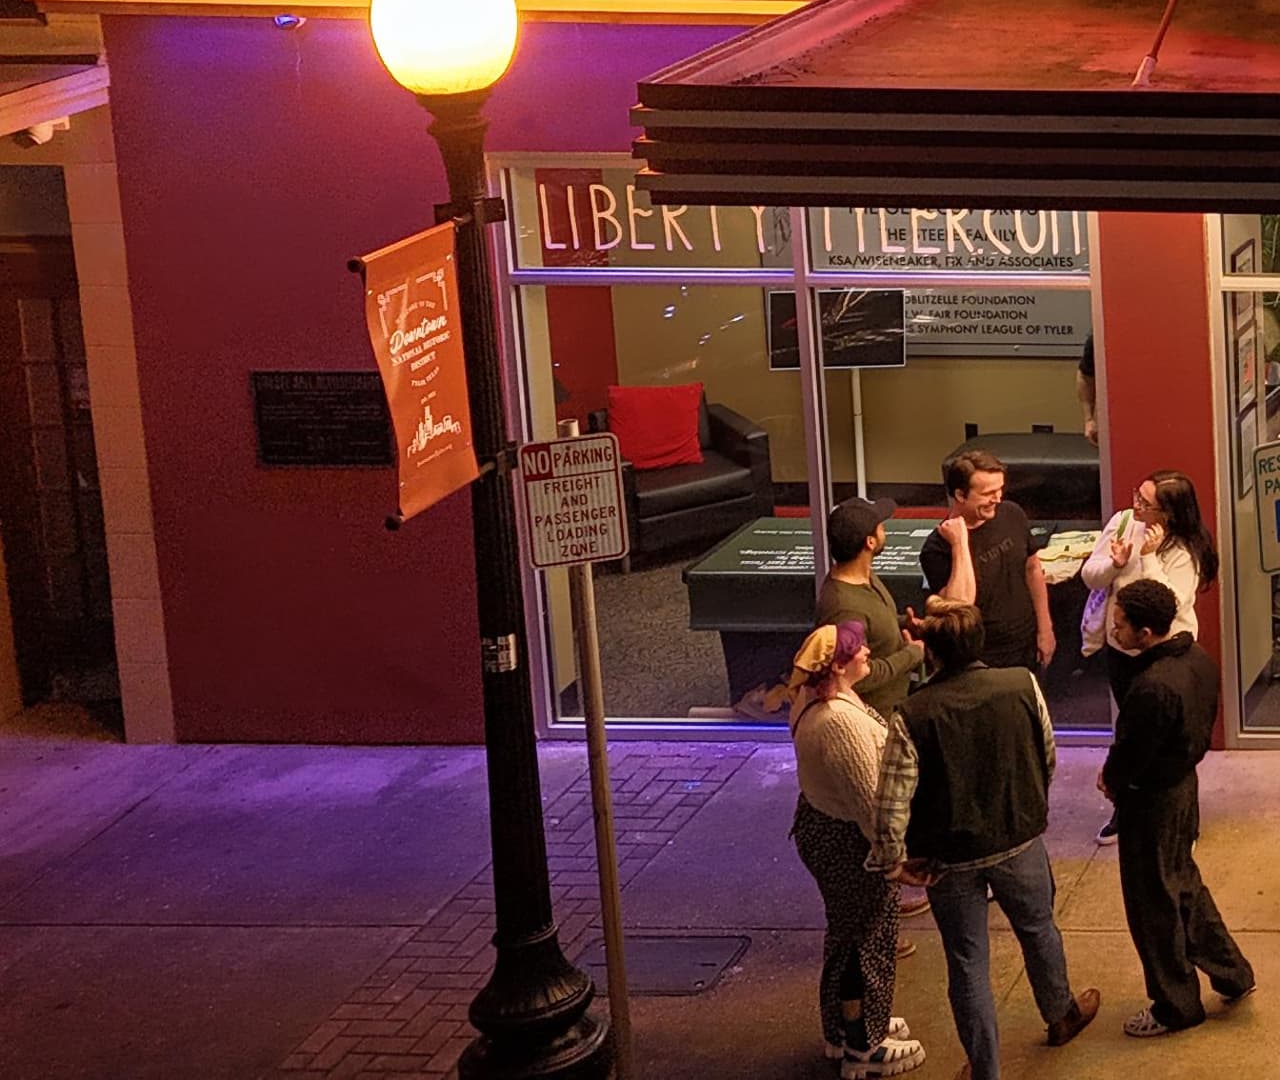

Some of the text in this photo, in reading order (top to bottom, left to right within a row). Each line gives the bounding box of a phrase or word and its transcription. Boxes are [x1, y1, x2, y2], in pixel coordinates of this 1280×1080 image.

[998, 256, 1074, 268] ASSOCIATES
[961, 295, 1037, 306] FOUNDATION
[954, 310, 1028, 320] FOUNDATION
[917, 324, 979, 335] SYMPHONY
[981, 325, 1024, 335] LEAGUE
[1026, 325, 1041, 335] OF
[1044, 325, 1074, 336] TYLER
[523, 446, 614, 476] NO PARKING
[544, 476, 601, 495] FREIGHT
[560, 494, 588, 509] AND
[535, 505, 617, 528] PASSENGER
[547, 523, 608, 543] LOADING
[561, 541, 598, 558] ZONE
